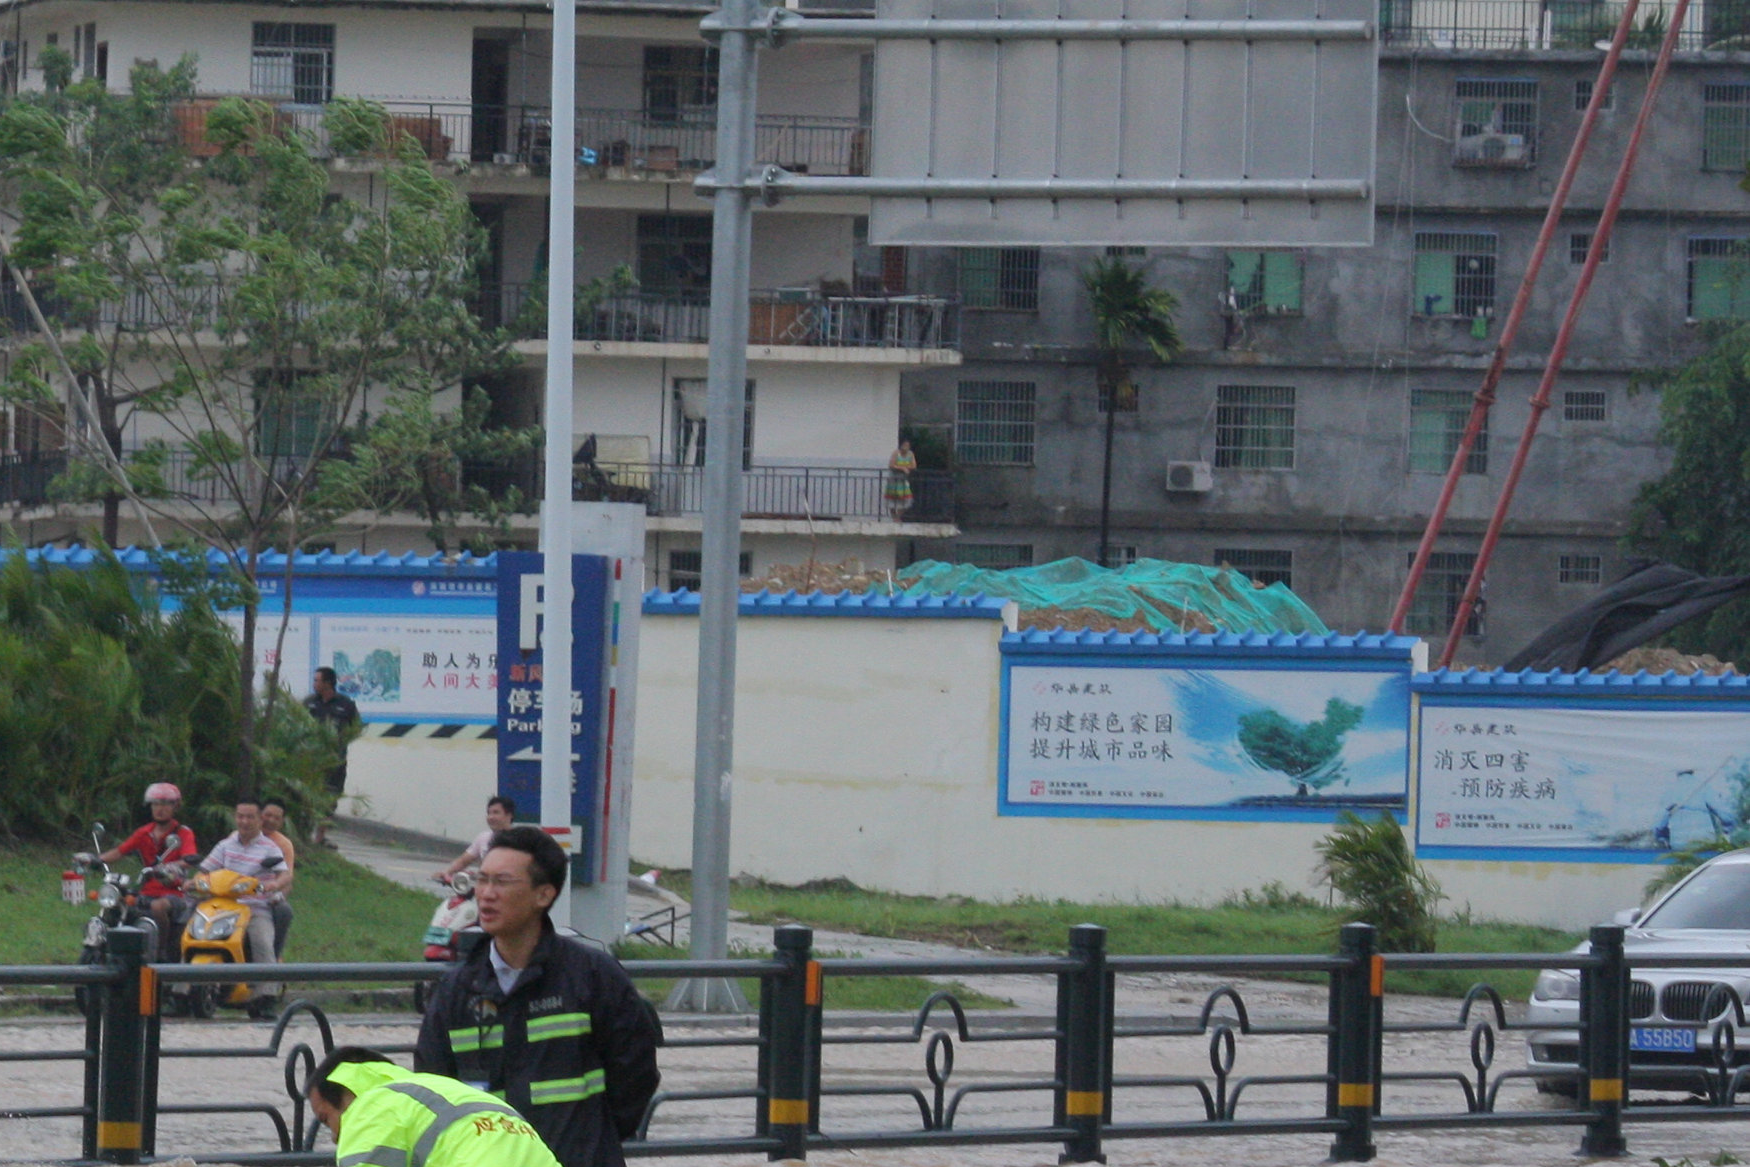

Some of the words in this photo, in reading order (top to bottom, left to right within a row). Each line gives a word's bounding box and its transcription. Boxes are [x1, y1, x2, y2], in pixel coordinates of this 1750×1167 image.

[1031, 711, 1172, 734] 构建绿色家园
[1030, 738, 1173, 762] 提升城市品味
[1434, 749, 1530, 773] 消灭四害
[1459, 777, 1557, 800] 预防疾病
